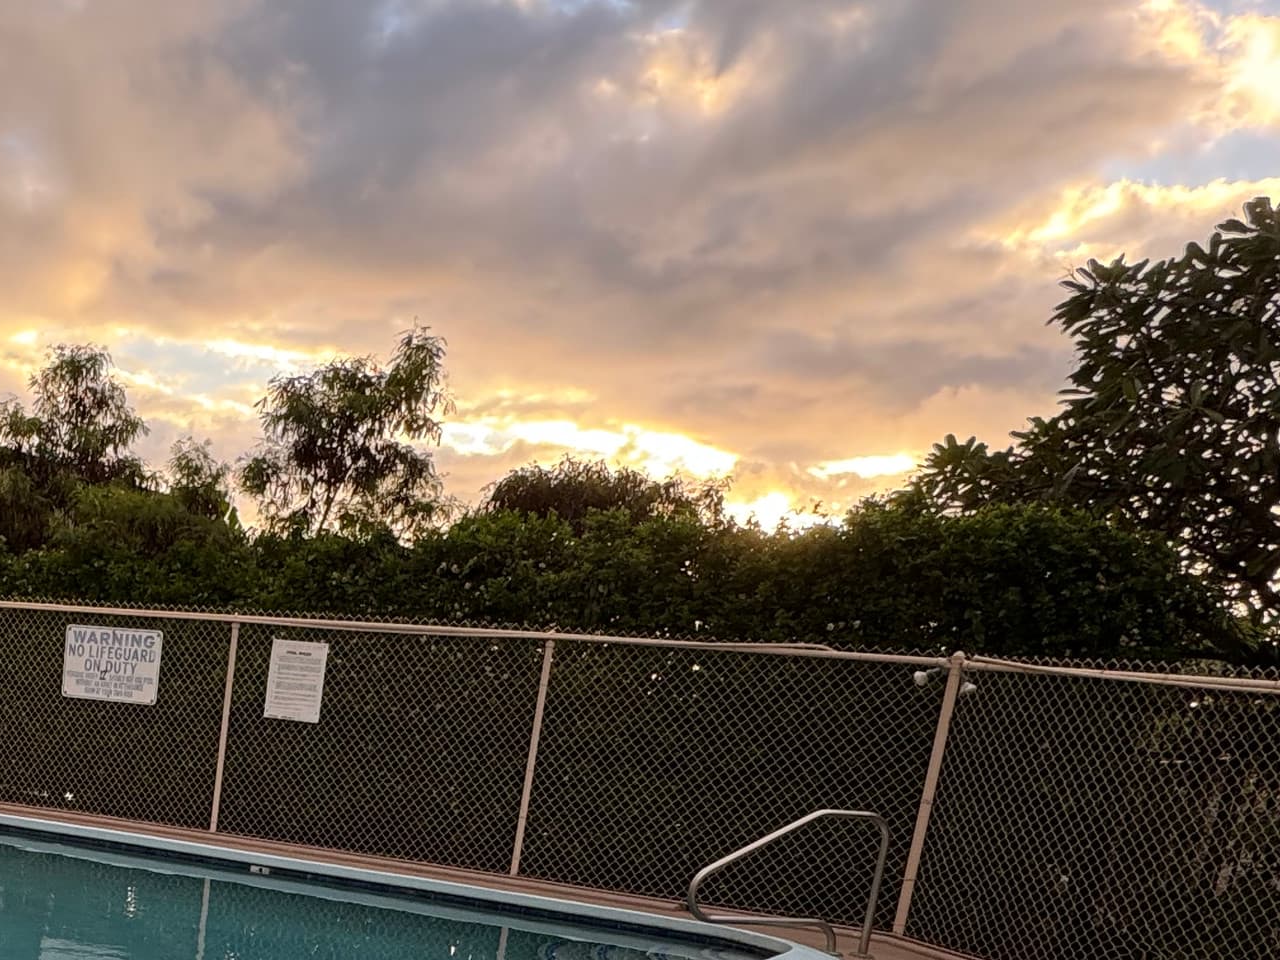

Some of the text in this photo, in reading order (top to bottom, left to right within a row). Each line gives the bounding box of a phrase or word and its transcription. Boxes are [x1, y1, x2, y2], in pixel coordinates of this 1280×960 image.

[73, 630, 156, 648] WARNING
[68, 644, 156, 663] NO LIFEGUARD
[84, 659, 101, 672] ON
[105, 660, 138, 675] DUTY
